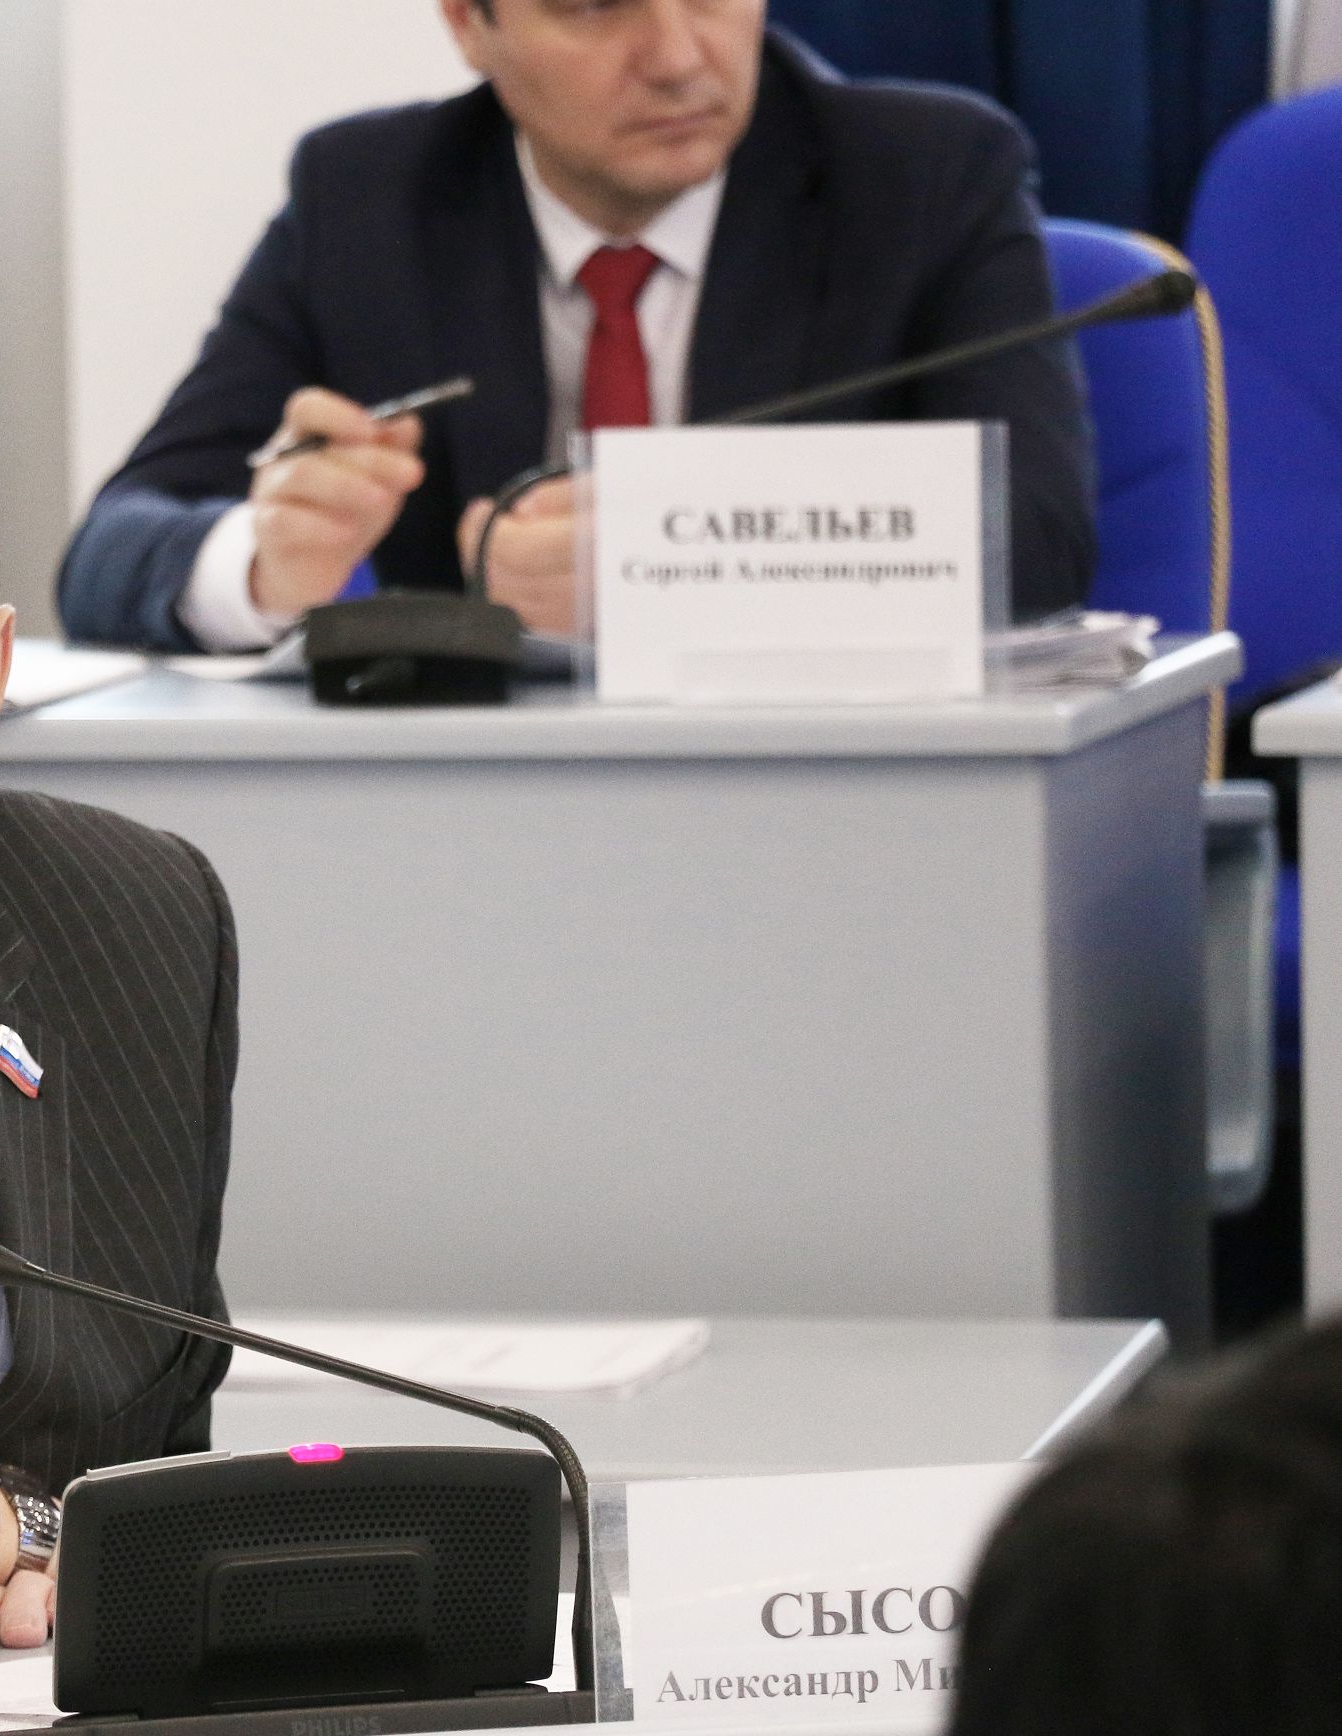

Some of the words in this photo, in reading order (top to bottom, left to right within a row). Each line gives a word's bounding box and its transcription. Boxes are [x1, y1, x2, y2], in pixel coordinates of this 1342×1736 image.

[661, 505, 917, 544] САВЕЛЬЕВ
[620, 557, 724, 588] Сергей
[735, 557, 959, 588] Александрович
[656, 1669, 879, 1703] Александр
